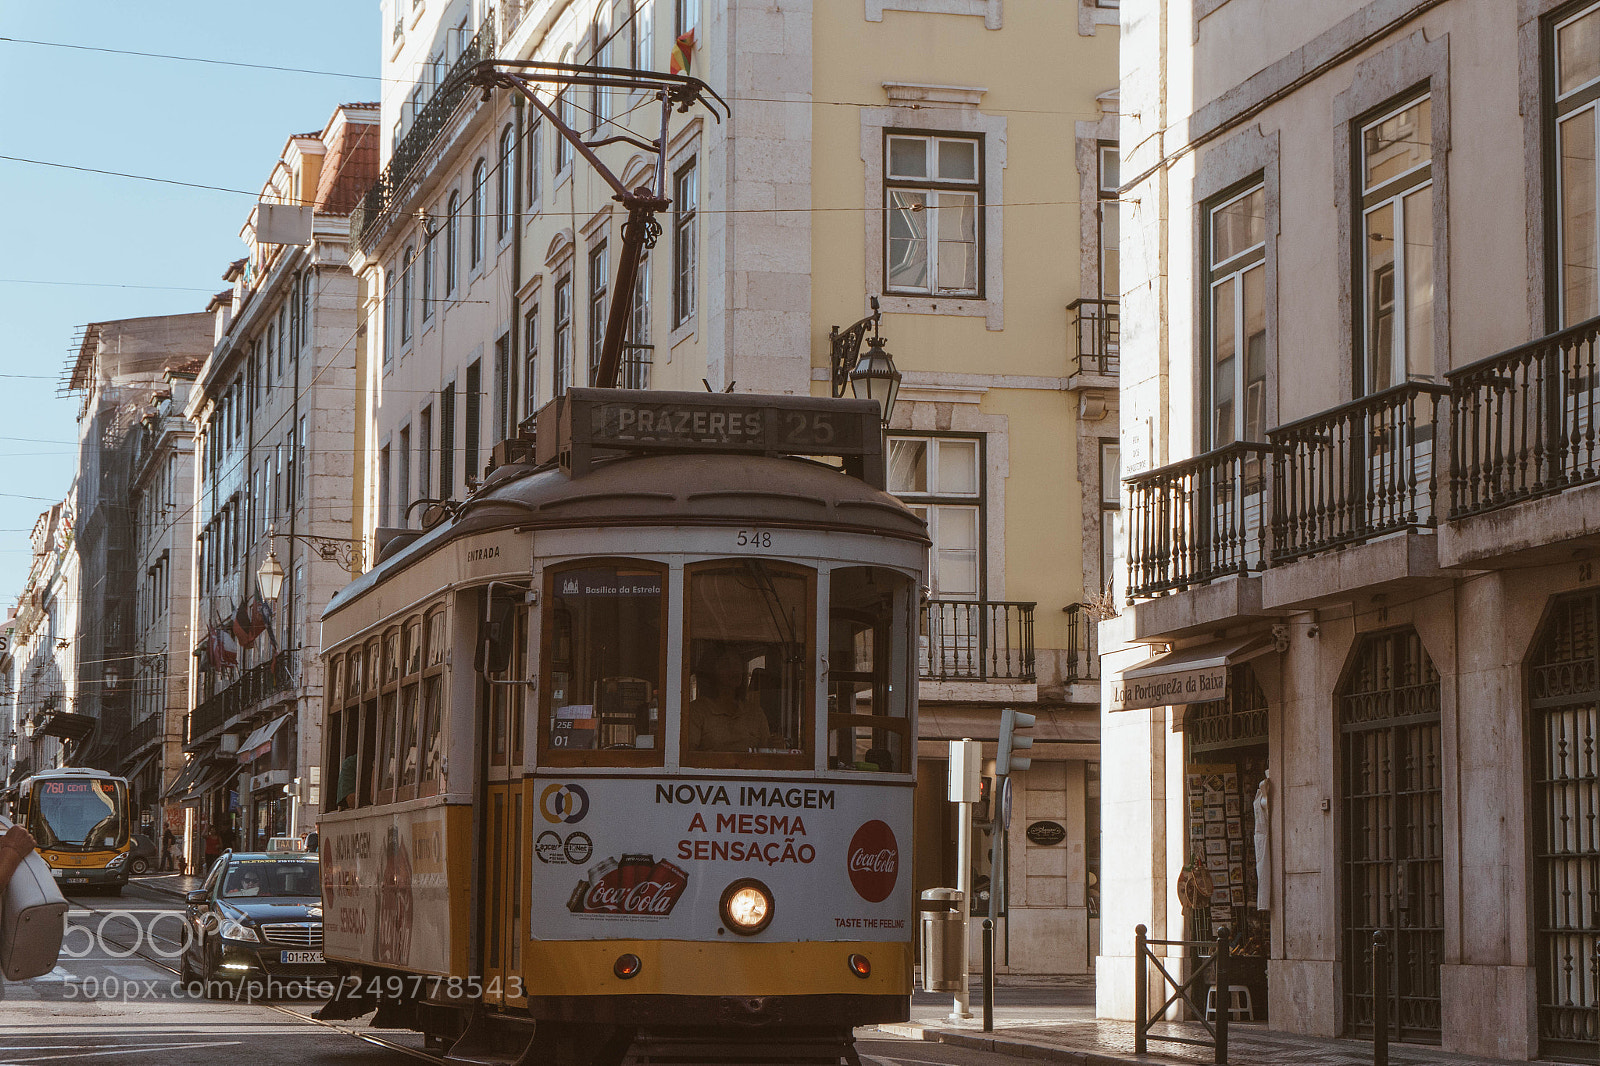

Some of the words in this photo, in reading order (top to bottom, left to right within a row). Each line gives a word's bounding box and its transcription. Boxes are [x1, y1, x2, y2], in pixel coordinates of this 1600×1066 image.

[619, 408, 761, 436] PRAZERES
[785, 413, 835, 444] 25
[736, 530, 772, 548] 548
[467, 546, 500, 563] ENTRADA
[619, 586, 630, 594] da
[632, 585, 661, 594] Estrela
[1114, 686, 1132, 706] Loja
[1134, 677, 1182, 701] PortugueZa
[1185, 675, 1197, 693] da
[1199, 672, 1224, 691] Baixa
[556, 721, 573, 729] 25E
[554, 735, 569, 747] 01
[46, 782, 64, 794] 760
[655, 784, 731, 806] NOVA
[740, 786, 835, 810] IMAGEM
[687, 812, 708, 833] A
[716, 813, 807, 836] MESMA
[677, 837, 816, 867] SENSAÇÃO
[850, 847, 897, 873] Coca-Cola
[583, 879, 678, 914] Coca-Cola
[834, 917, 862, 928] TASTE
[863, 918, 878, 928] THE
[879, 919, 905, 929] FEELING
